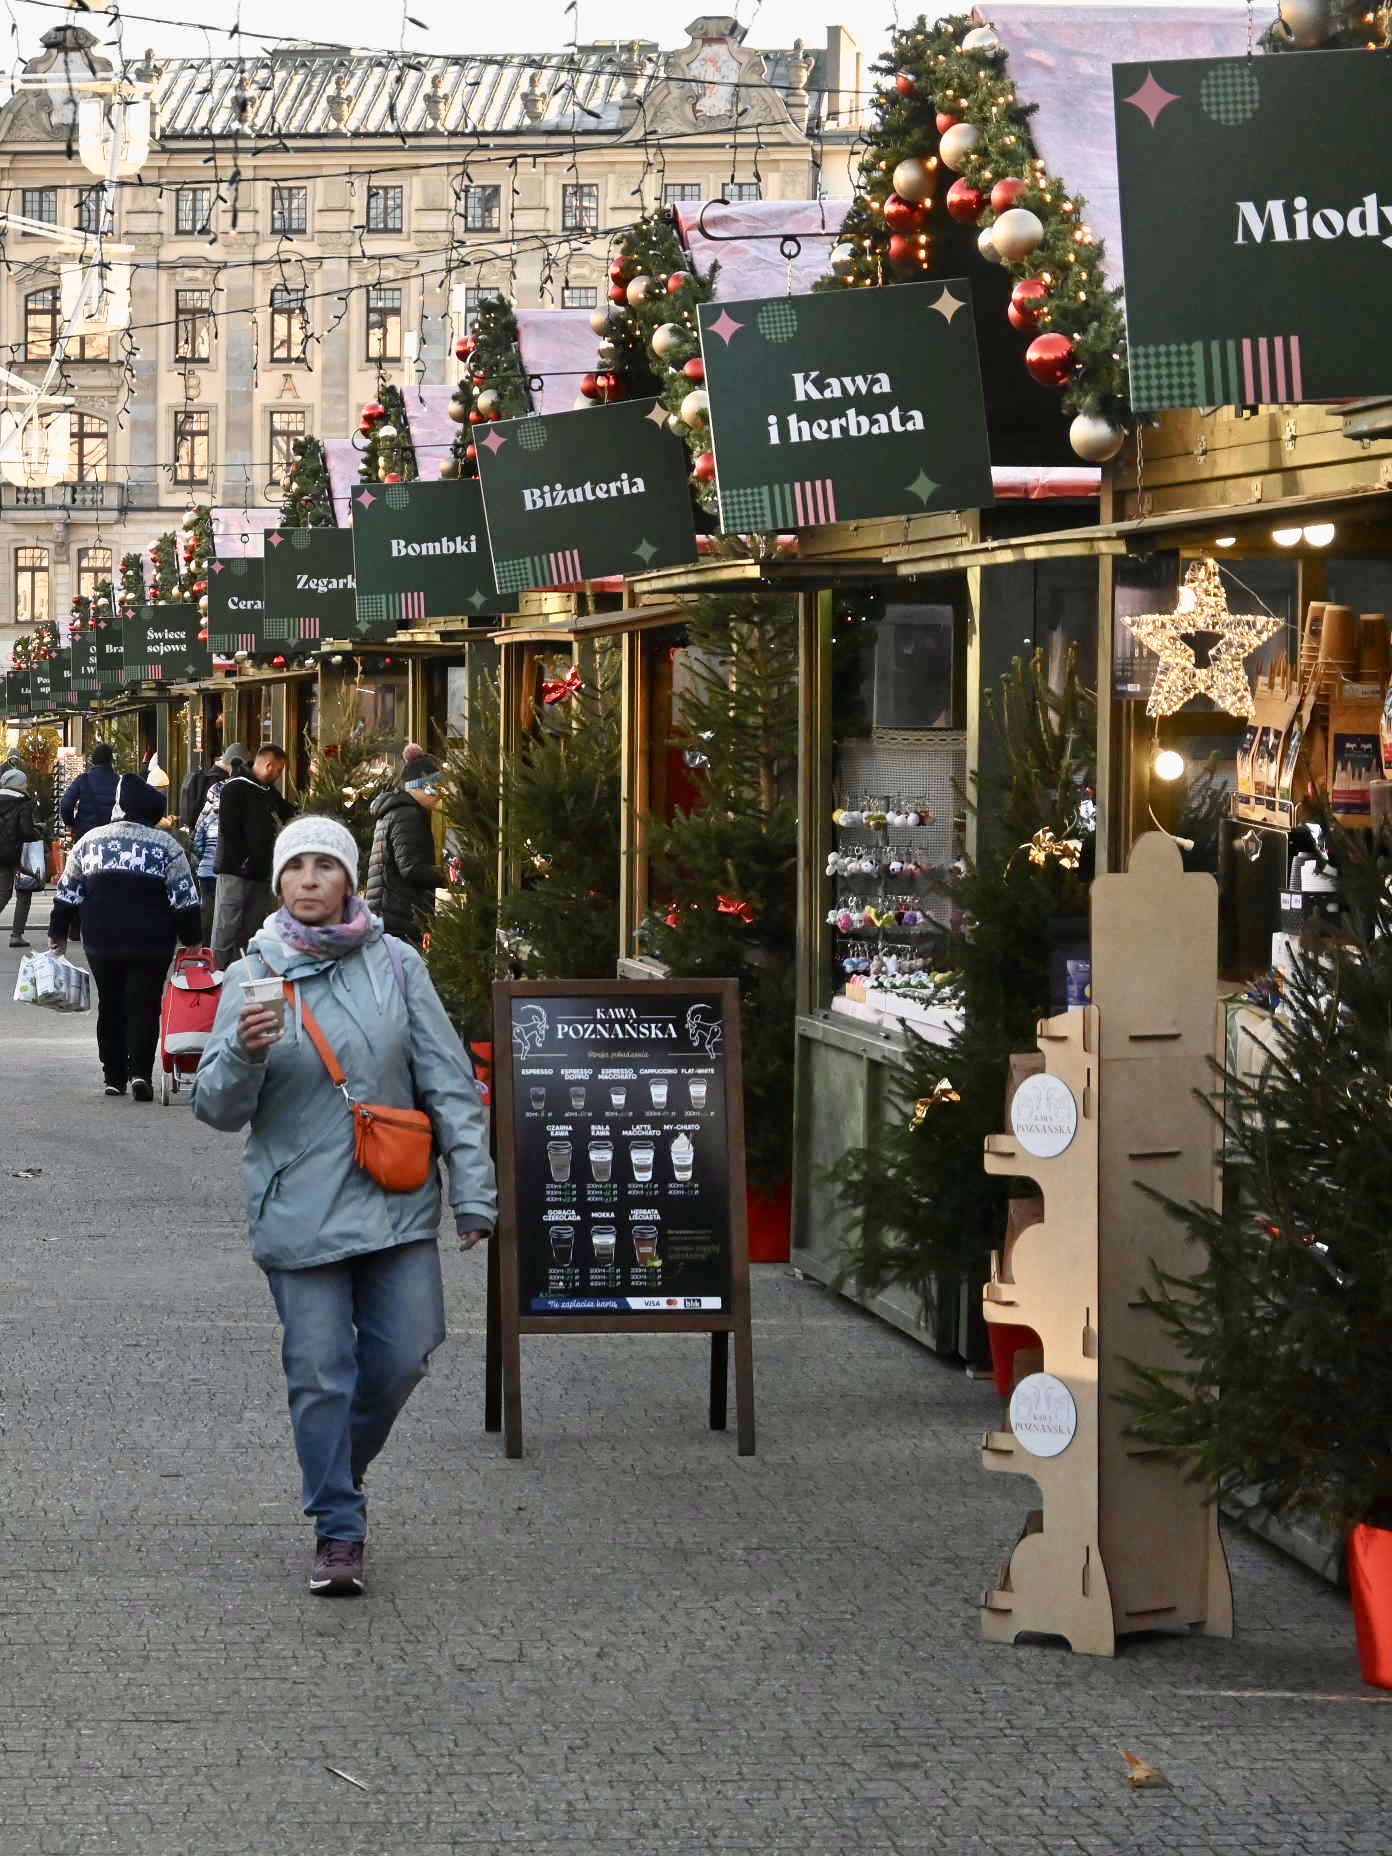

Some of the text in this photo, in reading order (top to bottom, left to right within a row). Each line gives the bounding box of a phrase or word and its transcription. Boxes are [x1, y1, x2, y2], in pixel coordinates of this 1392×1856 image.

[792, 370, 893, 404] Kawa
[768, 405, 925, 445] i herbata
[522, 472, 646, 511] Biżuteria
[391, 535, 477, 557] Bombki
[228, 596, 264, 609] Cera
[147, 628, 186, 640] Świece
[147, 643, 187, 655] sojowe
[596, 1008, 637, 1019] KAWA
[557, 1019, 678, 1039] POZNAŃSKA
